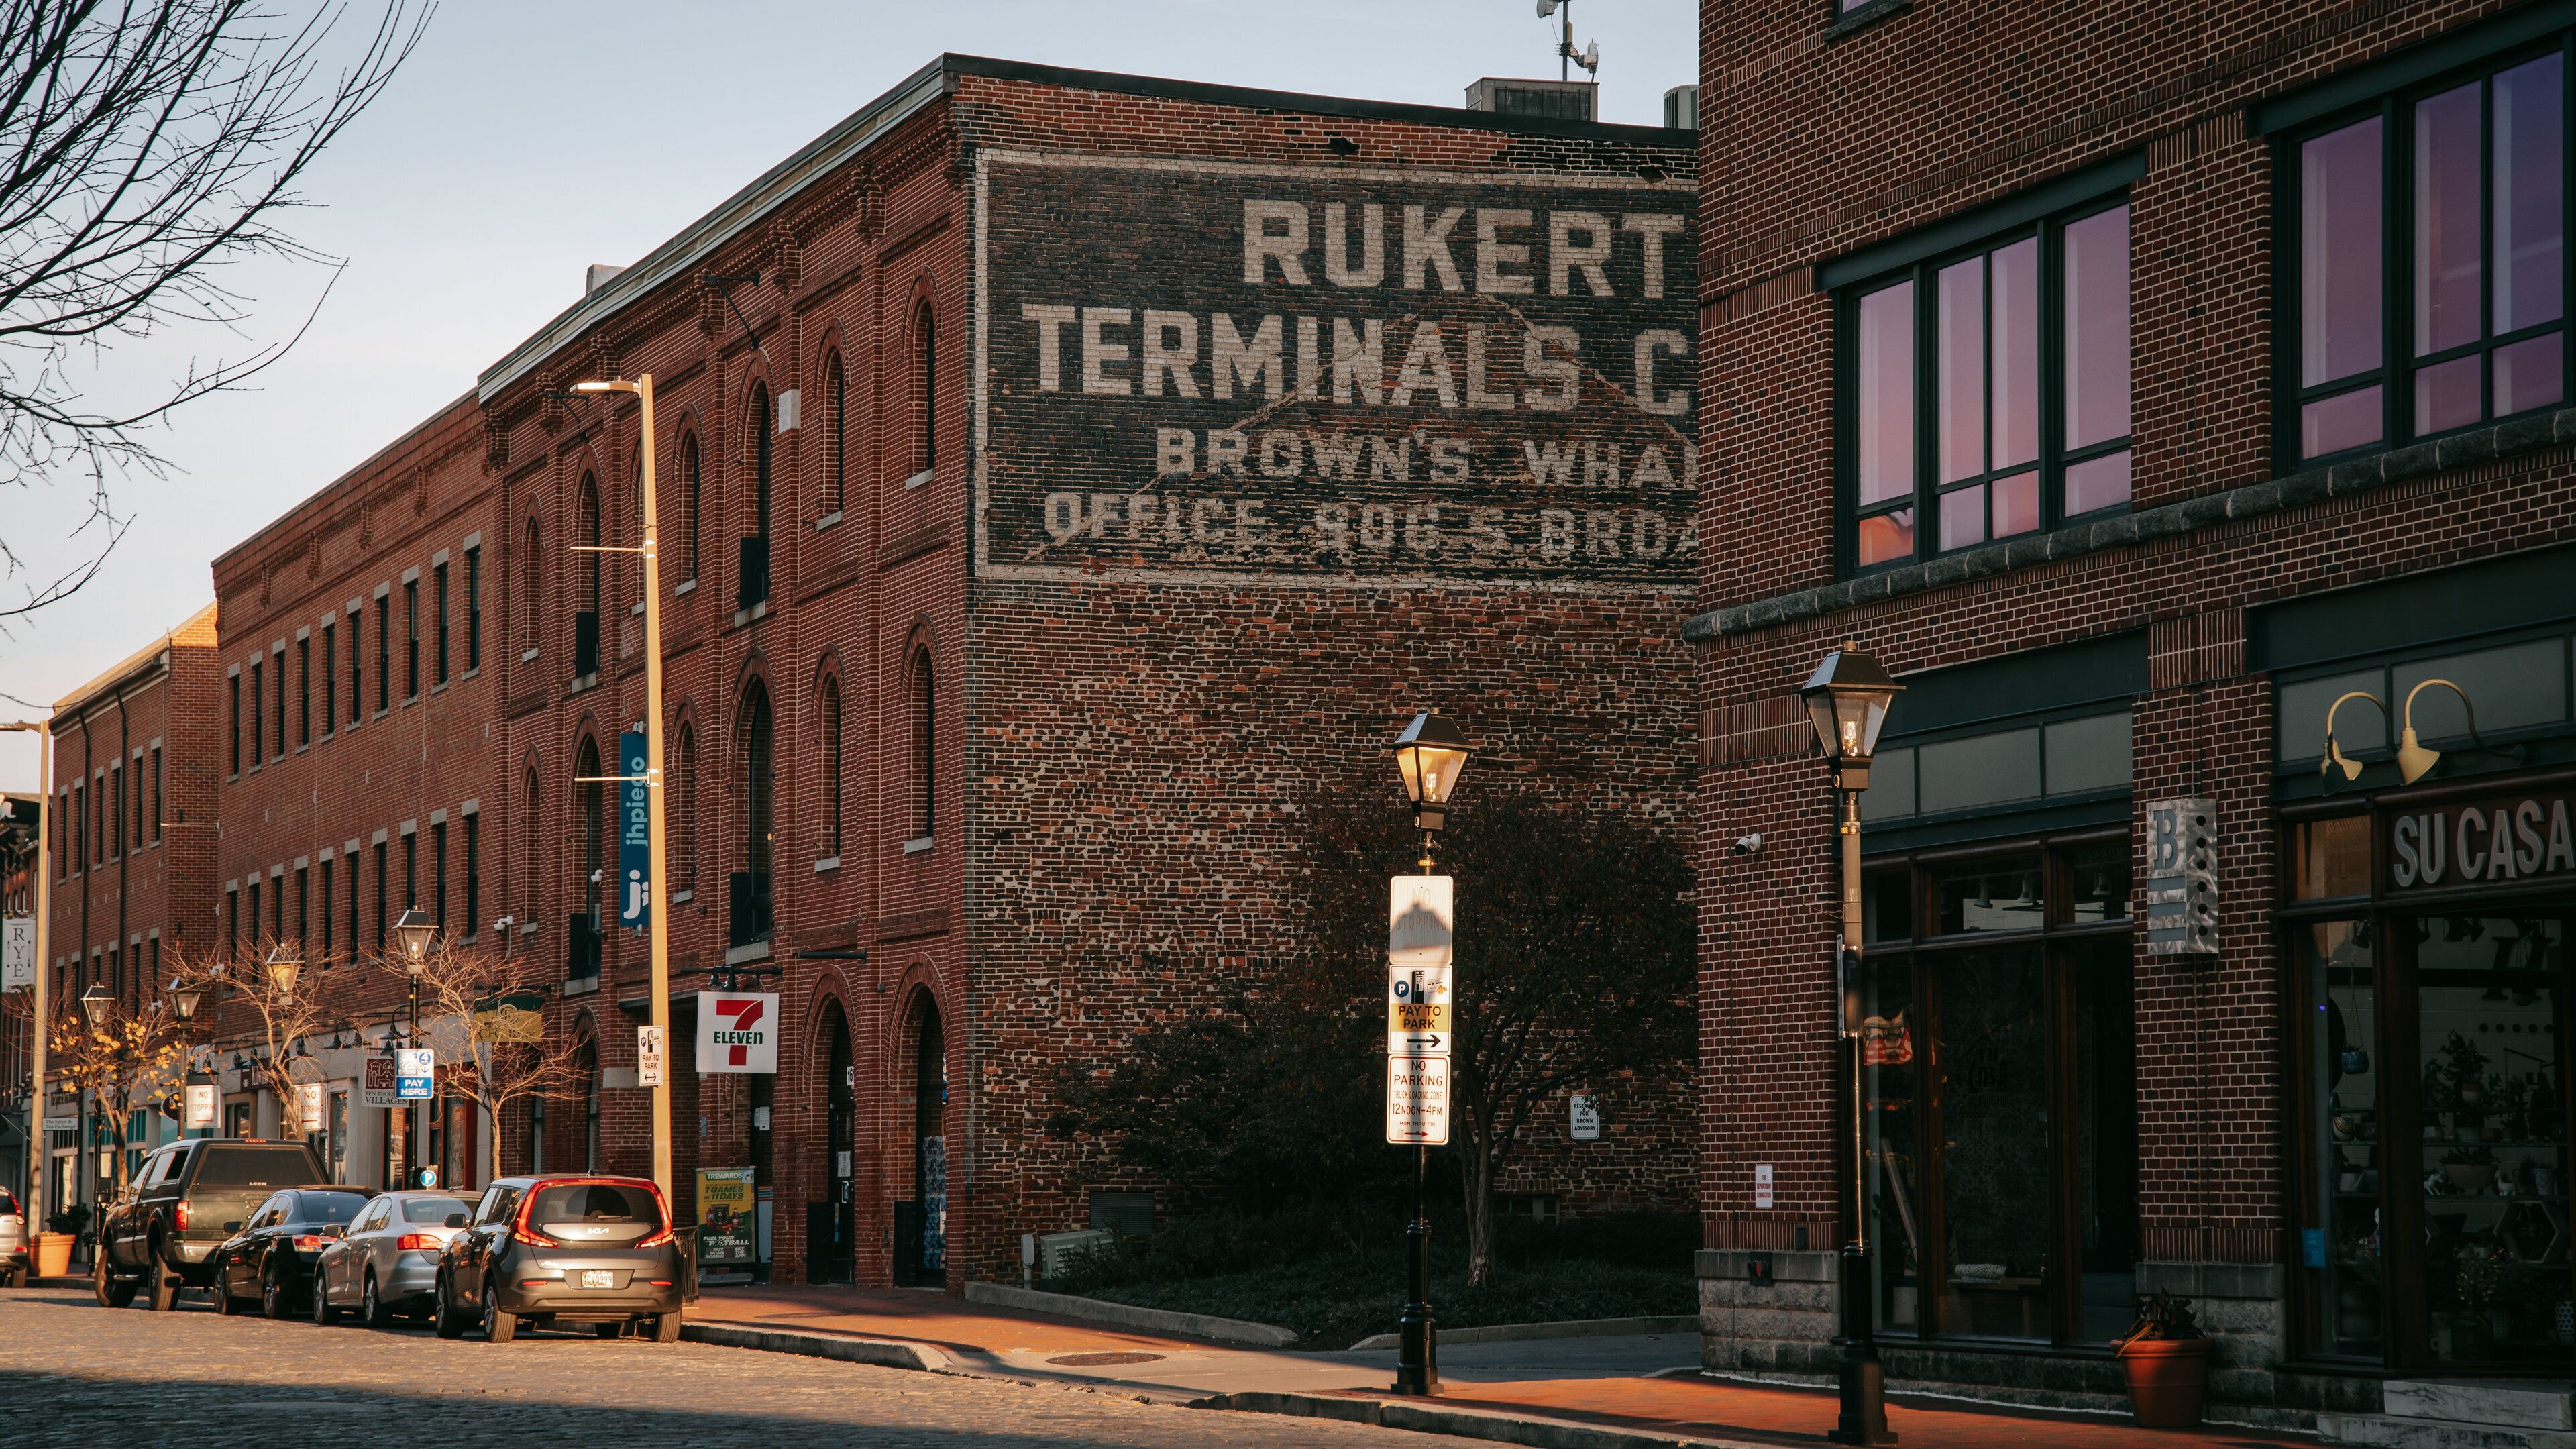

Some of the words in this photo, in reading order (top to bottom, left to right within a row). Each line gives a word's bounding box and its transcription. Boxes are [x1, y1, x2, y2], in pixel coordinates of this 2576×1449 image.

[1243, 199, 1686, 299] RUKERT
[1022, 303, 1582, 411] TERMINALS
[1156, 427, 1471, 483] BROWN'S
[1044, 492, 1267, 542] OFFICE
[2153, 808, 2179, 871] B
[2393, 812, 2447, 888] SU
[2457, 799, 2576, 880] CASA
[1411, 888, 1431, 906] NO
[1395, 915, 1447, 931] STOPPING
[1399, 1005, 1421, 1016] PAY
[1425, 1005, 1442, 1016] TO
[1403, 1018, 1436, 1029] PARK
[716, 999, 764, 1066] 7
[1411, 1060, 1426, 1071] NO
[1393, 1075, 1444, 1086] PARKING
[199, 1091, 209, 1099] NO
[303, 1090, 317, 1099] NO
[1393, 1090, 1408, 1100] TRUCK
[1409, 1090, 1429, 1101] LOADING
[1430, 1091, 1443, 1100] ZONE
[365, 1096, 407, 1105] VILLAGES
[190, 1104, 218, 1112] STOPPING
[301, 1104, 324, 1114] TOPPING
[711, 1185, 744, 1193] GAMES
[718, 1192, 744, 1200] DAYS
